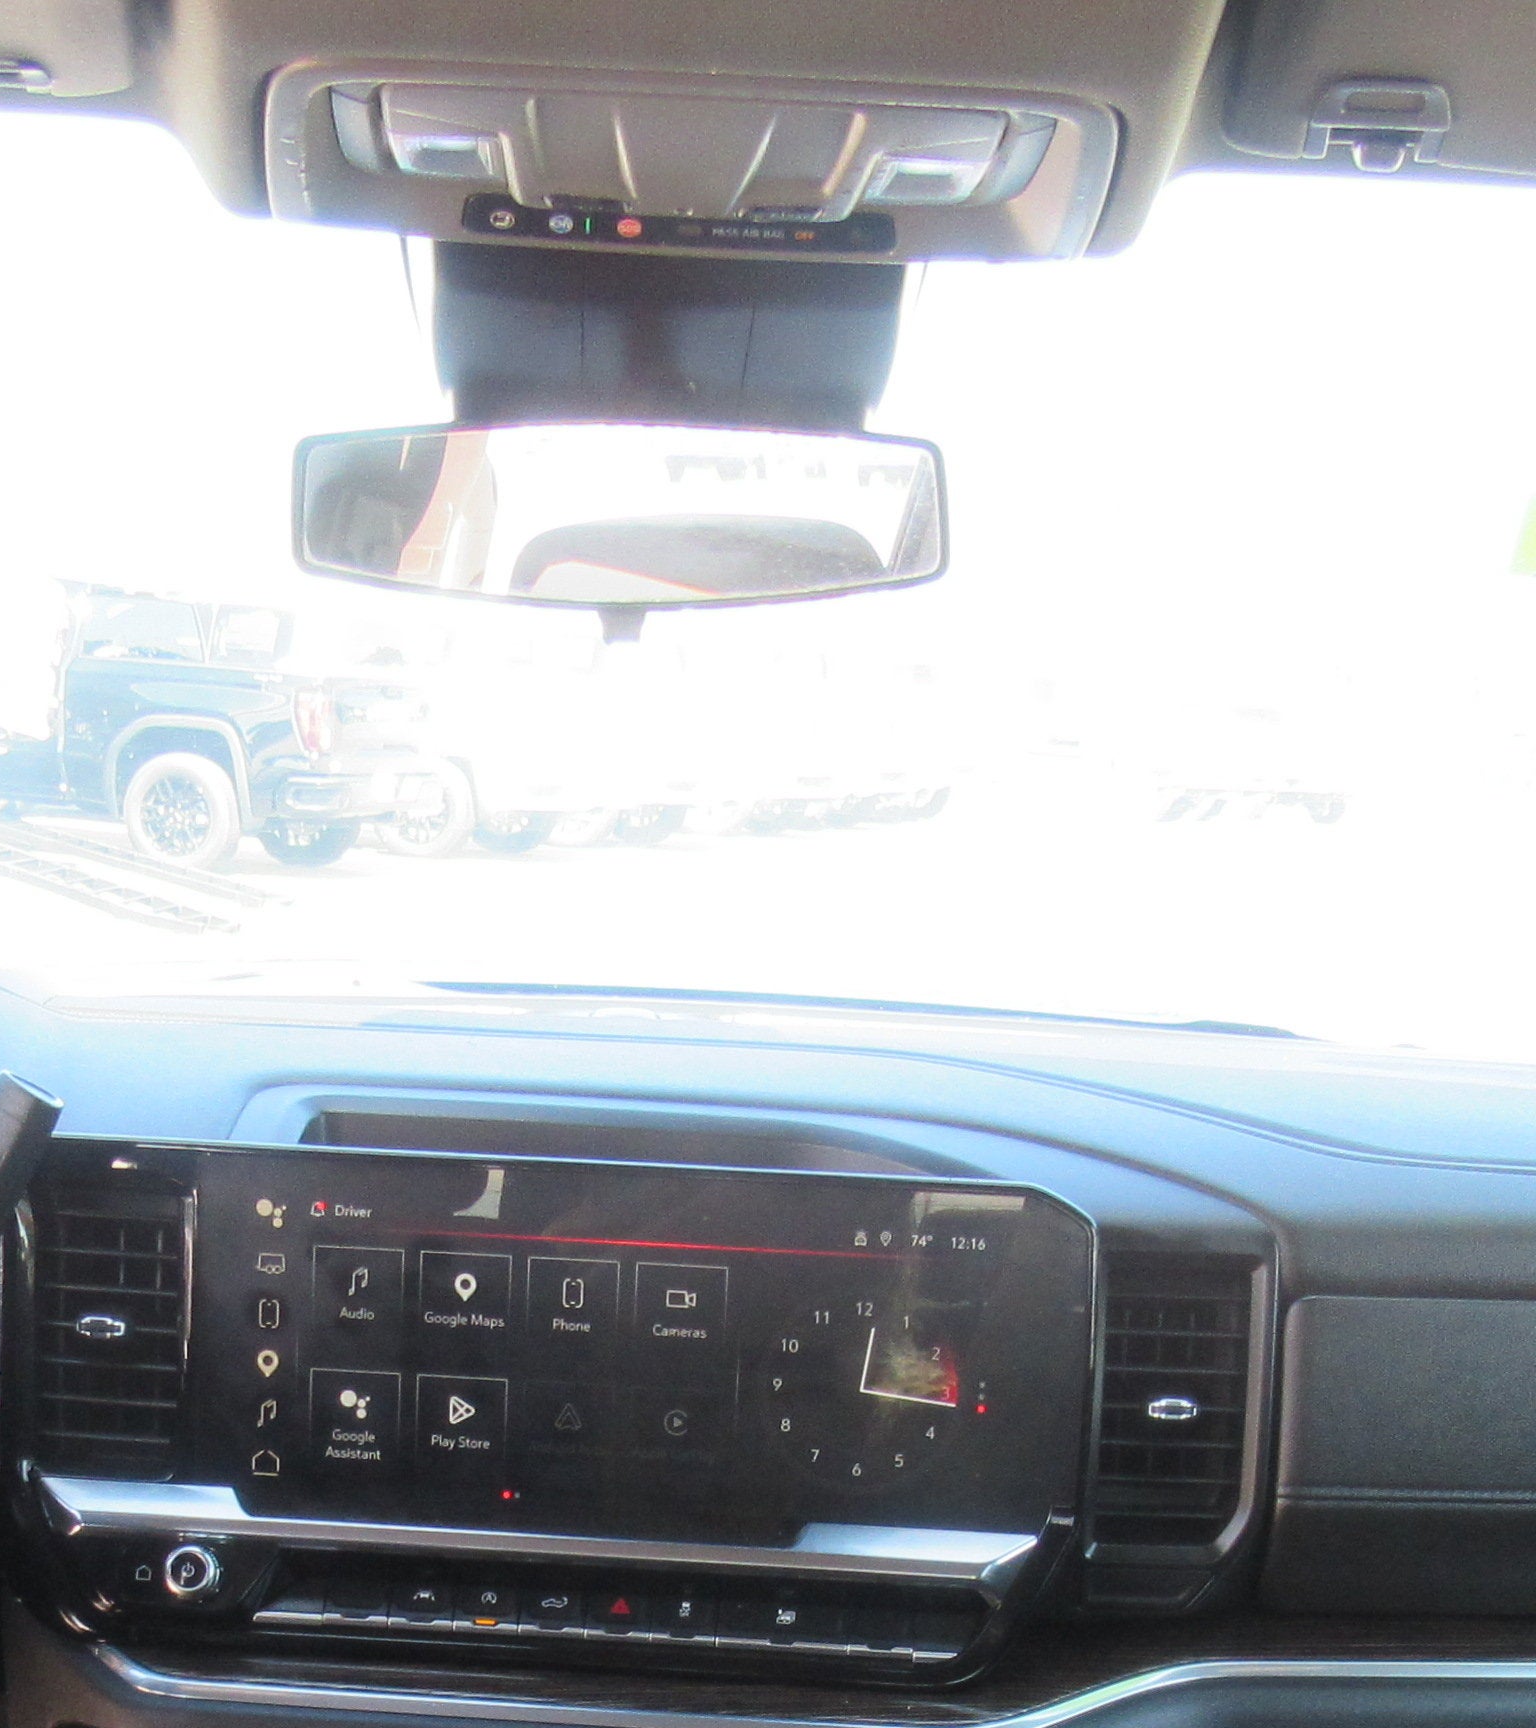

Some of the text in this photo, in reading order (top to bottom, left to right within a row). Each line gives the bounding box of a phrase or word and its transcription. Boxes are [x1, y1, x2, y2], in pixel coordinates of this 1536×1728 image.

[794, 230, 816, 241] OFF
[334, 1204, 373, 1219] Driver
[951, 1236, 986, 1251] 12:16
[339, 1307, 375, 1321] Audio
[855, 1302, 874, 1317] 12
[424, 1311, 505, 1329] Google Maps
[552, 1318, 591, 1333] Phone
[814, 1311, 831, 1325] 11
[902, 1316, 910, 1329] 1
[652, 1323, 708, 1340] Cameras
[780, 1339, 800, 1354] 10
[931, 1347, 942, 1361] 2
[772, 1378, 783, 1392] 9
[941, 1386, 951, 1400] 3
[780, 1418, 792, 1433] 8
[925, 1426, 936, 1440] 4
[332, 1429, 376, 1445] Google
[431, 1435, 491, 1450] Play Store
[325, 1446, 381, 1461] Assistant
[810, 1449, 821, 1463] 7
[894, 1454, 905, 1469] 5
[851, 1463, 862, 1477] 6
